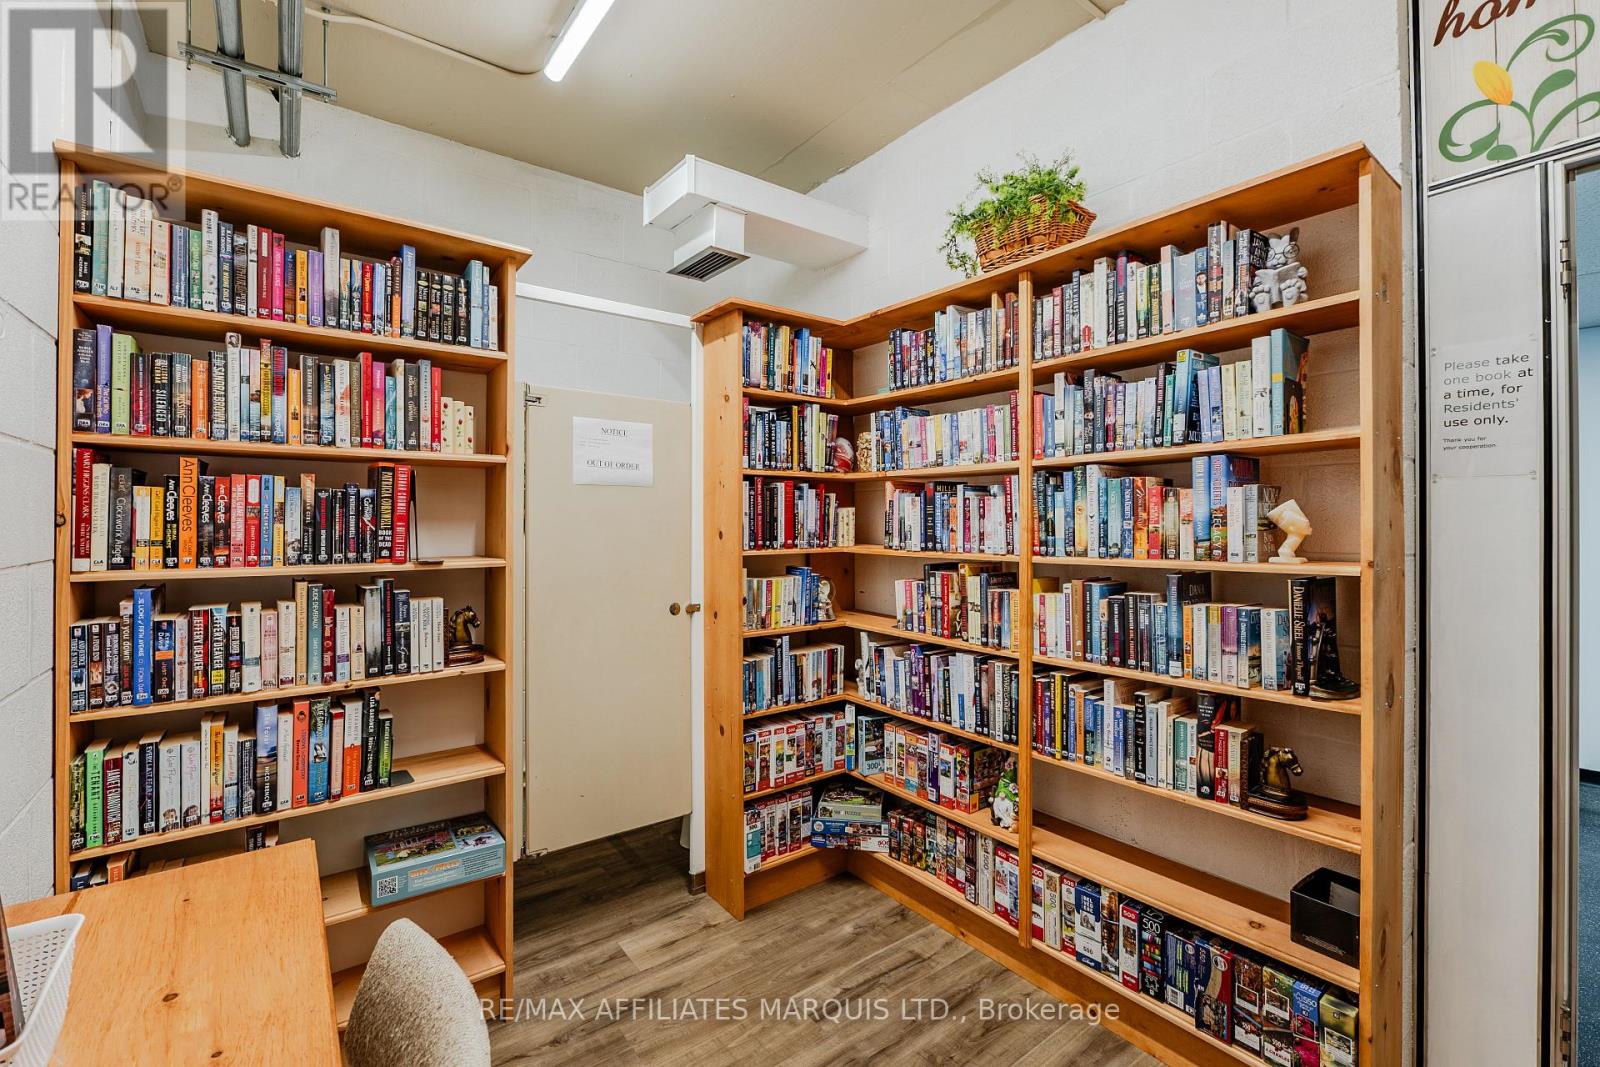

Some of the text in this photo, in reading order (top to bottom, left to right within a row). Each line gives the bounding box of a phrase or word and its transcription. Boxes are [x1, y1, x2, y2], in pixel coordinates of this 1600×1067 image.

[1443, 367, 1534, 386] one book at
[1444, 354, 1529, 372] Please take
[155, 389, 167, 422] SILENCED
[176, 393, 186, 418] MISSING
[213, 367, 226, 423] SANDRA BROWN
[1443, 383, 1524, 400] a time, for
[1444, 398, 1519, 414] Residents'
[1443, 414, 1509, 428] use only.
[1464, 436, 1476, 444] you
[615, 462, 641, 471] ORDER
[81, 453, 91, 518] MARY HIGGINS CLARK
[165, 479, 178, 521] Ann Cleeves
[181, 459, 196, 532] Ann Cleeves
[380, 471, 393, 529] PATRICIA CORNWELL
[1037, 477, 1045, 516] ruth rendell
[1212, 478, 1223, 506] ROBERTS
[201, 483, 213, 523] Ann Cleeves
[217, 494, 229, 524] Cleeves
[111, 497, 126, 558] Clockwork Ange
[1211, 513, 1222, 548] LEGACY
[312, 587, 320, 629] JUDE DEVERAUX
[1293, 586, 1306, 641] DANIELLE STEEL
[119, 627, 132, 661] you down
[193, 616, 203, 671] JEFFERY DEAVER
[211, 615, 222, 668] JEFFERY DEAVER
[1295, 642, 1305, 681] Honor Thyself
[145, 745, 153, 763] EVERY
[145, 764, 153, 777] LAST
[91, 771, 101, 800] TENANT
[106, 768, 121, 823] JANET EVANOVICH
[1142, 919, 1161, 933] 500
